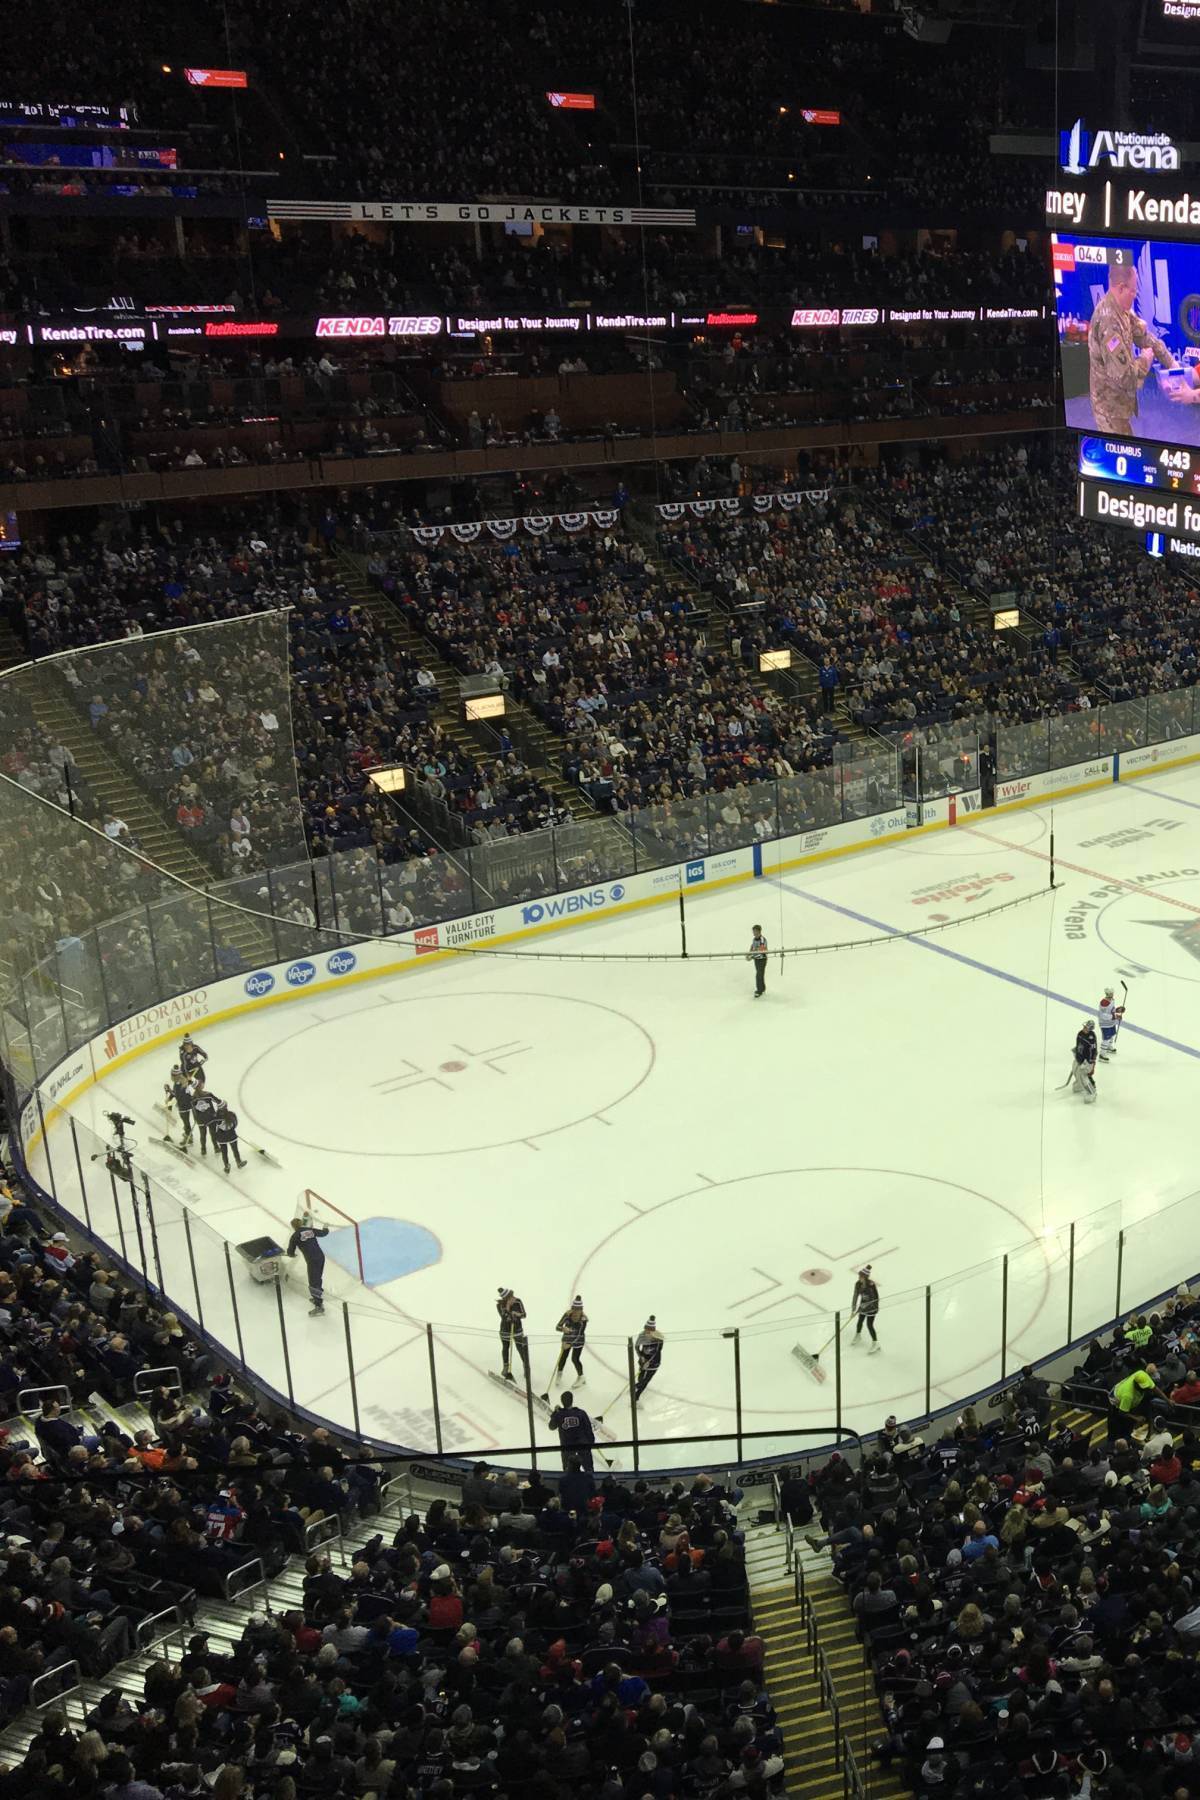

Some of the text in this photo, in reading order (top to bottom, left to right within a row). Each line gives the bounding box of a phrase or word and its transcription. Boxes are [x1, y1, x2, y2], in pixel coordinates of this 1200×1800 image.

[1115, 131, 1170, 145] Nationwide
[1089, 131, 1178, 169] Arena
[362, 206, 624, 222] LET'S GO JACKETS
[1079, 247, 1102, 262] 04.6
[1115, 249, 1123, 264] 3
[316, 318, 384, 337] KENDA
[388, 316, 441, 335] TIRES
[458, 316, 502, 332] Designed
[505, 316, 518, 329] for
[520, 316, 542, 329] Your
[544, 316, 580, 330] Journey
[596, 315, 666, 327] KendaTire.com
[792, 309, 1037, 325] KENDA TIRES Designed for Your Journey KendaTire.com
[41, 326, 145, 341] KendaTire.com
[205, 322, 278, 337] TireDiscounters
[1105, 443, 1142, 476] COLUMBUS 0
[1159, 449, 1190, 470] 4:43
[1143, 466, 1157, 474] SHOTS
[1167, 470, 1184, 488] PERIOD 2
[1098, 490, 1177, 528] Designed
[1126, 754, 1150, 765] VECTOR
[1002, 781, 1031, 797] Wyler
[688, 867, 703, 877] IGS
[911, 872, 1015, 905] Safelite
[520, 889, 605, 924] 10 WBNS
[445, 921, 472, 935] VALUE
[475, 914, 495, 928] CITY
[1064, 900, 1101, 940] Arena
[447, 925, 495, 946] FURNITURE
[328, 955, 356, 975] Kroger
[287, 966, 315, 986] Kroger
[246, 977, 274, 997] Kroger
[119, 990, 208, 1039] ELDORADO
[121, 1004, 209, 1052] SCIOTO DOWNS
[57, 1063, 83, 1089] NHL.COM
